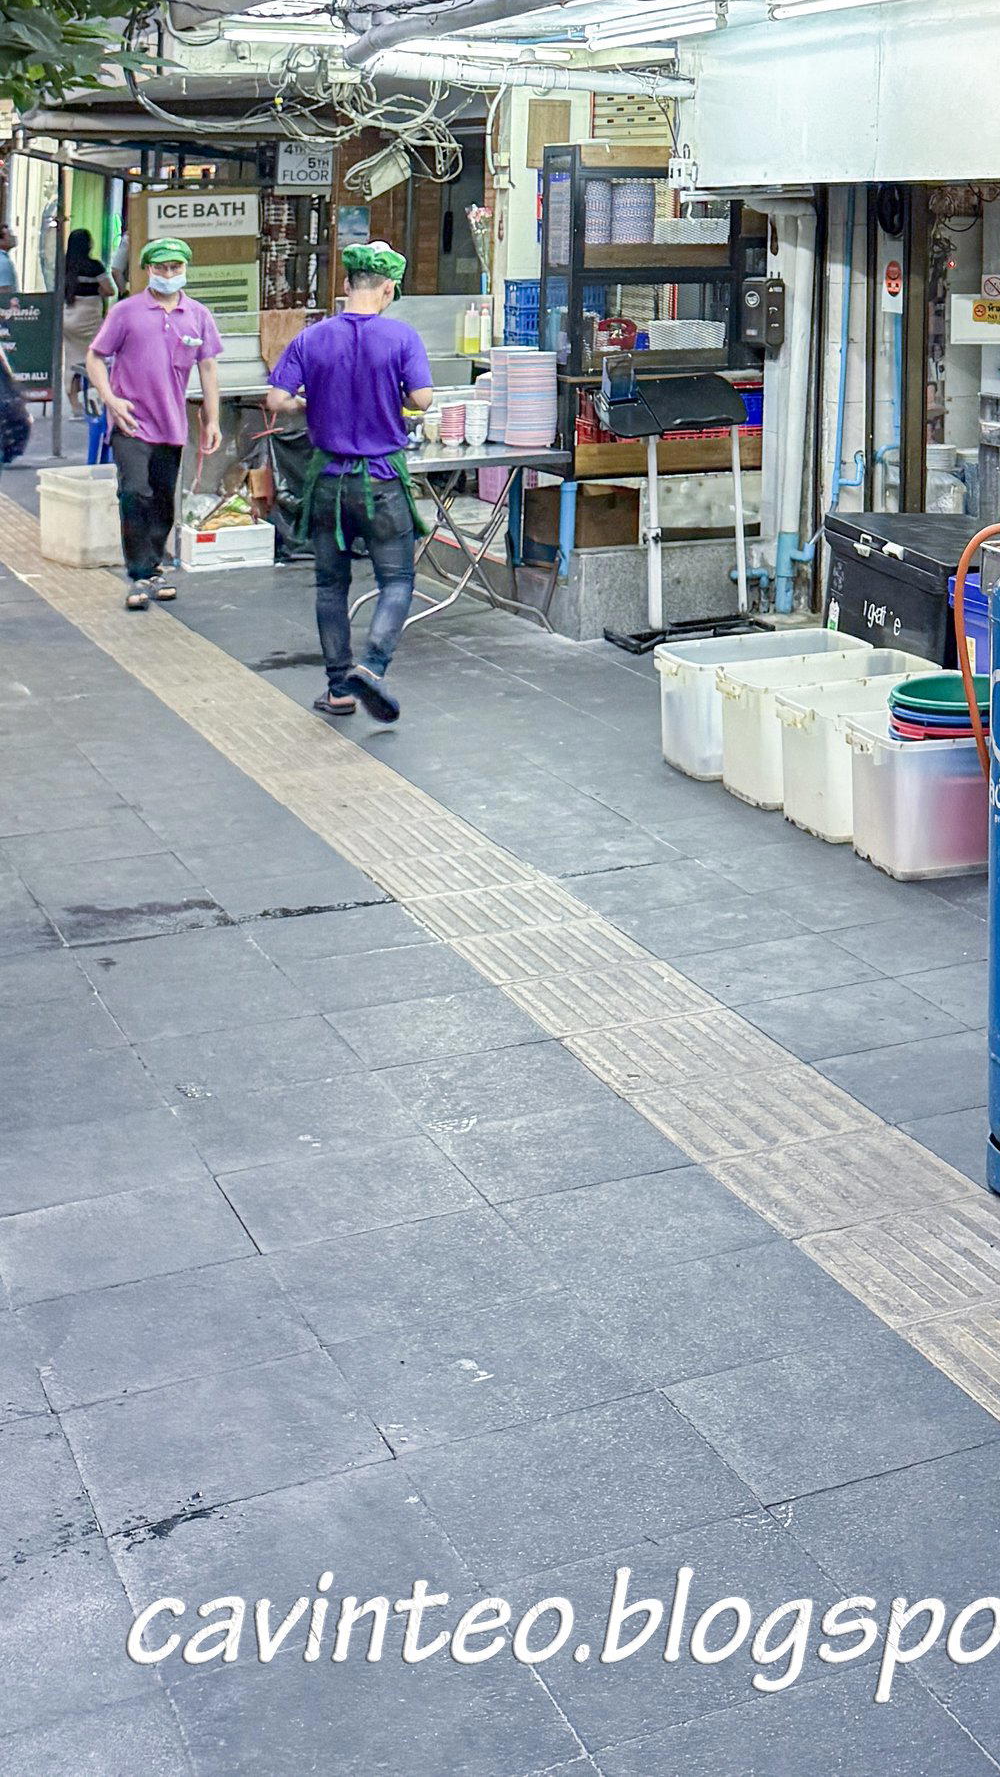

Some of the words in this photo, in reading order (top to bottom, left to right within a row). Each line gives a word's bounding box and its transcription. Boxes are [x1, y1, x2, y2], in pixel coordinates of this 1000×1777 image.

[308, 157, 329, 169] 5TH
[282, 169, 329, 182] FLOOR
[157, 204, 188, 219] ICE
[193, 201, 245, 217] BATH
